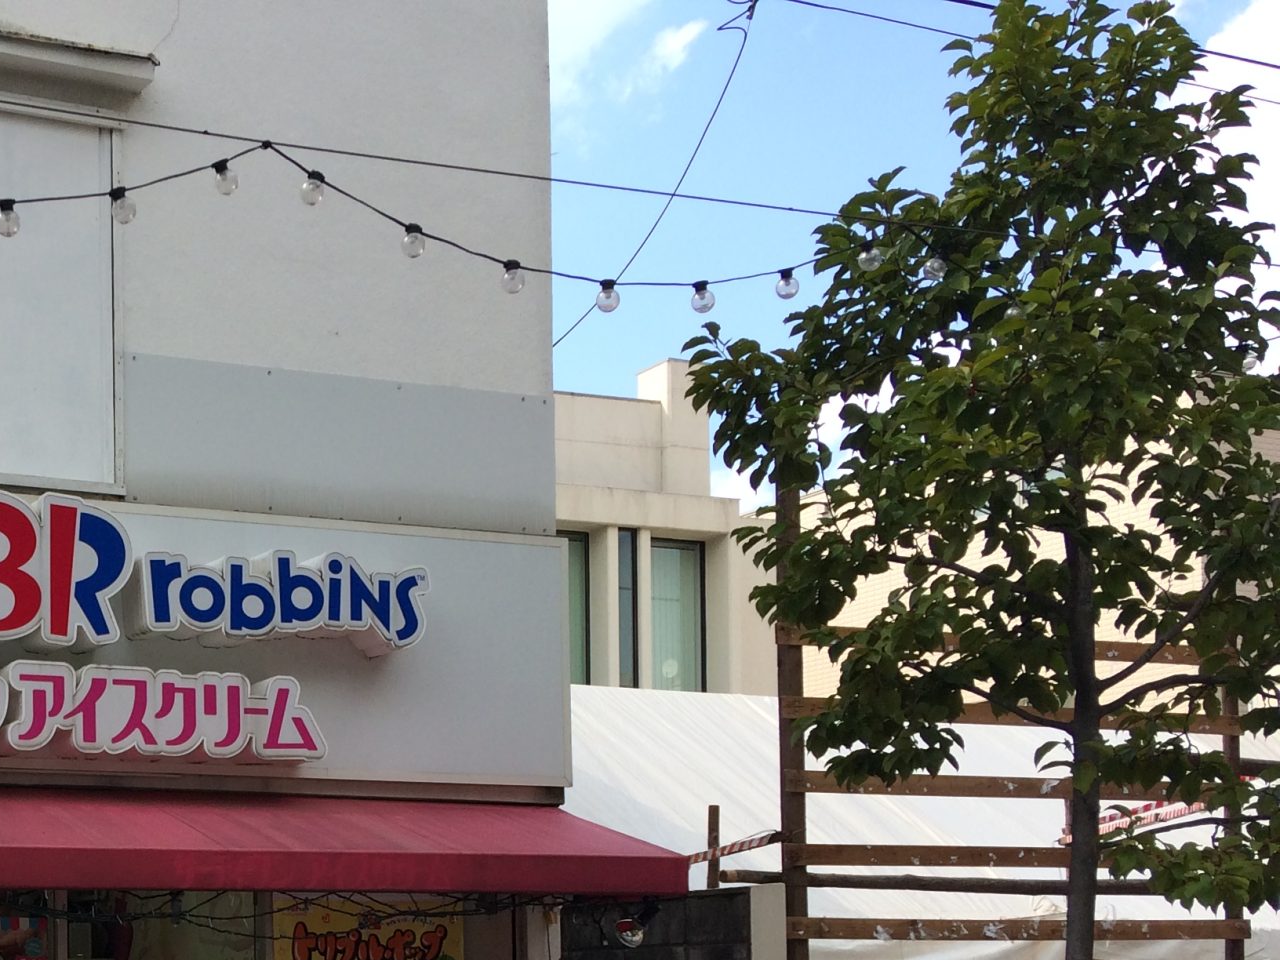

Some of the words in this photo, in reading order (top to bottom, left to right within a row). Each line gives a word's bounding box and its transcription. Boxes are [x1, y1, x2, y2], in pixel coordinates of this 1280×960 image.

[13, 673, 318, 751] アイスクリーム
